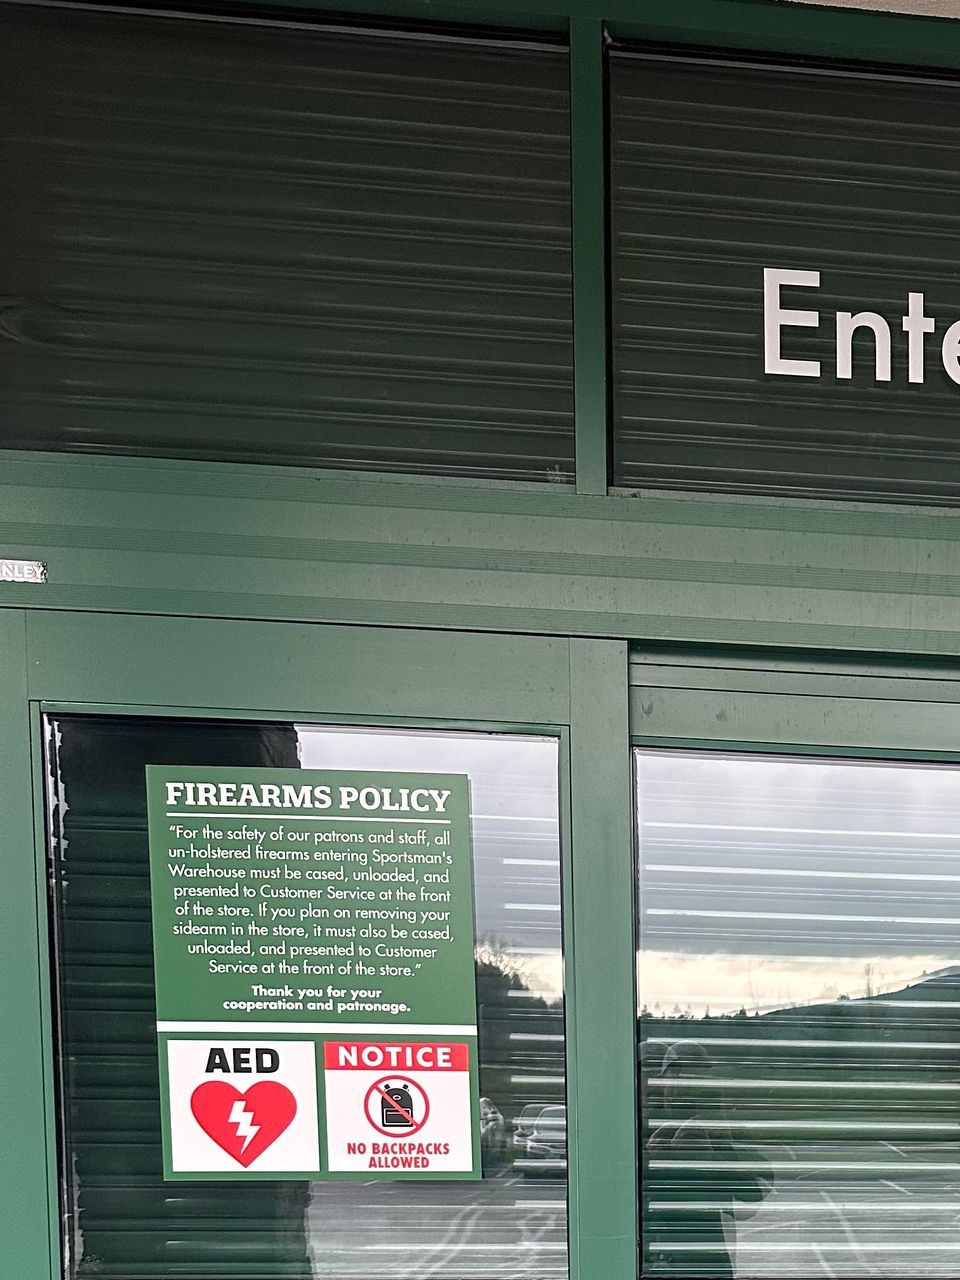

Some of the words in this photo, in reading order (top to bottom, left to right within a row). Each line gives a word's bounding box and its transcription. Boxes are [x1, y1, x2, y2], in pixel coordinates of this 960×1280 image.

[0, 565, 43, 579] NLEY
[165, 782, 332, 808] FIREARMS
[339, 787, 451, 812] POLICY
[202, 826, 223, 840] the
[227, 826, 266, 845] safety
[270, 827, 284, 841] of
[288, 832, 310, 841] our
[314, 831, 364, 845] patrons
[368, 830, 394, 844] and
[398, 831, 430, 846] staff,
[435, 831, 451, 845] all
[168, 846, 251, 860] un-holstered
[255, 845, 310, 861] firearms
[314, 850, 368, 866] entering
[168, 864, 246, 879] Warehouse
[250, 867, 281, 879] must
[284, 868, 302, 879] be
[305, 867, 349, 882] cased,
[353, 868, 419, 884] unloaded,
[423, 869, 449, 883] and
[173, 886, 239, 899] presented
[243, 886, 256, 898] to
[260, 885, 323, 899] Customer
[327, 887, 375, 900] Service
[379, 889, 392, 901] at
[396, 889, 416, 901] the
[420, 890, 451, 902] front
[175, 903, 190, 917] of
[193, 905, 214, 917] the
[217, 906, 253, 917] store.
[258, 905, 268, 918] If
[271, 909, 296, 921] you
[300, 905, 329, 921] plan
[333, 909, 351, 919] on
[355, 909, 417, 924] removing
[421, 911, 450, 925] your
[173, 923, 226, 936] sidearm
[231, 924, 244, 936] in
[248, 924, 269, 936] the
[272, 925, 308, 938] store,
[313, 925, 321, 937] it
[325, 926, 356, 938] must
[360, 925, 387, 939] also
[392, 927, 408, 939] be
[412, 927, 454, 942] cased,
[188, 943, 255, 956] unloaded,
[260, 943, 286, 955] and
[290, 944, 354, 958] presented
[358, 945, 371, 956] to
[375, 945, 437, 958] Customer
[208, 960, 258, 974] Service
[261, 962, 275, 974] at
[279, 962, 299, 974] the
[303, 961, 334, 975] front
[338, 961, 352, 975] of
[355, 963, 376, 975] the
[251, 985, 293, 997] Thank
[298, 988, 323, 1000] you
[327, 986, 347, 997] for
[350, 989, 382, 1001] your
[223, 999, 303, 1012] cooperation
[307, 999, 333, 1010] and
[337, 1000, 411, 1014] patronage.
[205, 1048, 280, 1073] AED
[338, 1046, 453, 1068] NOTICE
[347, 1143, 366, 1154] NO
[372, 1143, 450, 1155] BACKPACKS
[368, 1156, 429, 1169] ALLOWED
